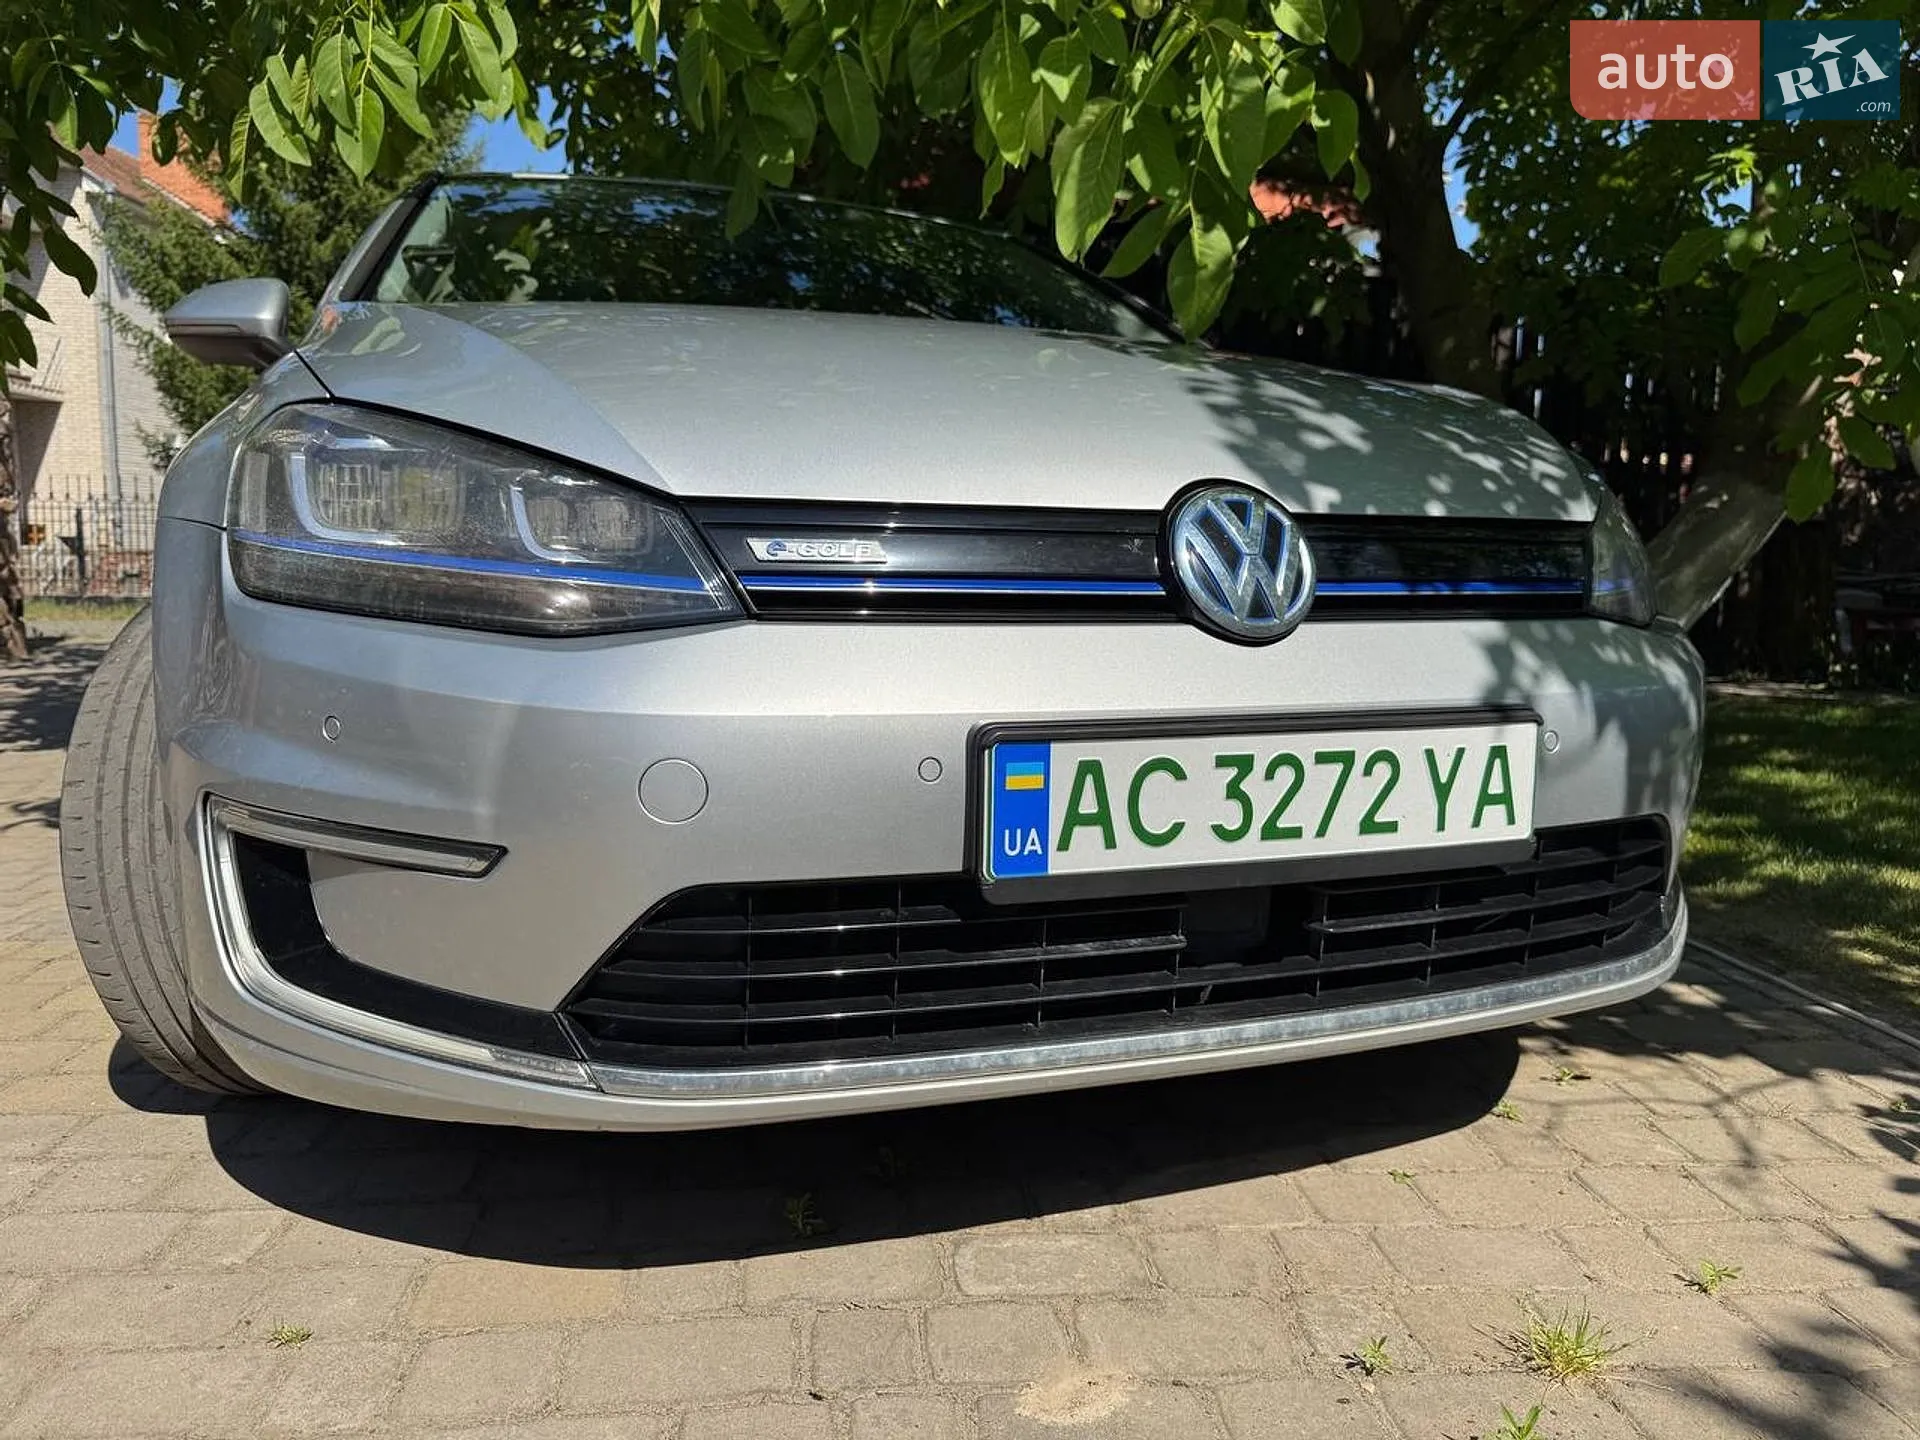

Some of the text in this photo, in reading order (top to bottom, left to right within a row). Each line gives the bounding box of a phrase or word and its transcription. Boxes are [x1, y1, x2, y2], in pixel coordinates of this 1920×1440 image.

[1056, 744, 1517, 852] AC 3272 YA
[1003, 827, 1043, 857] UA
